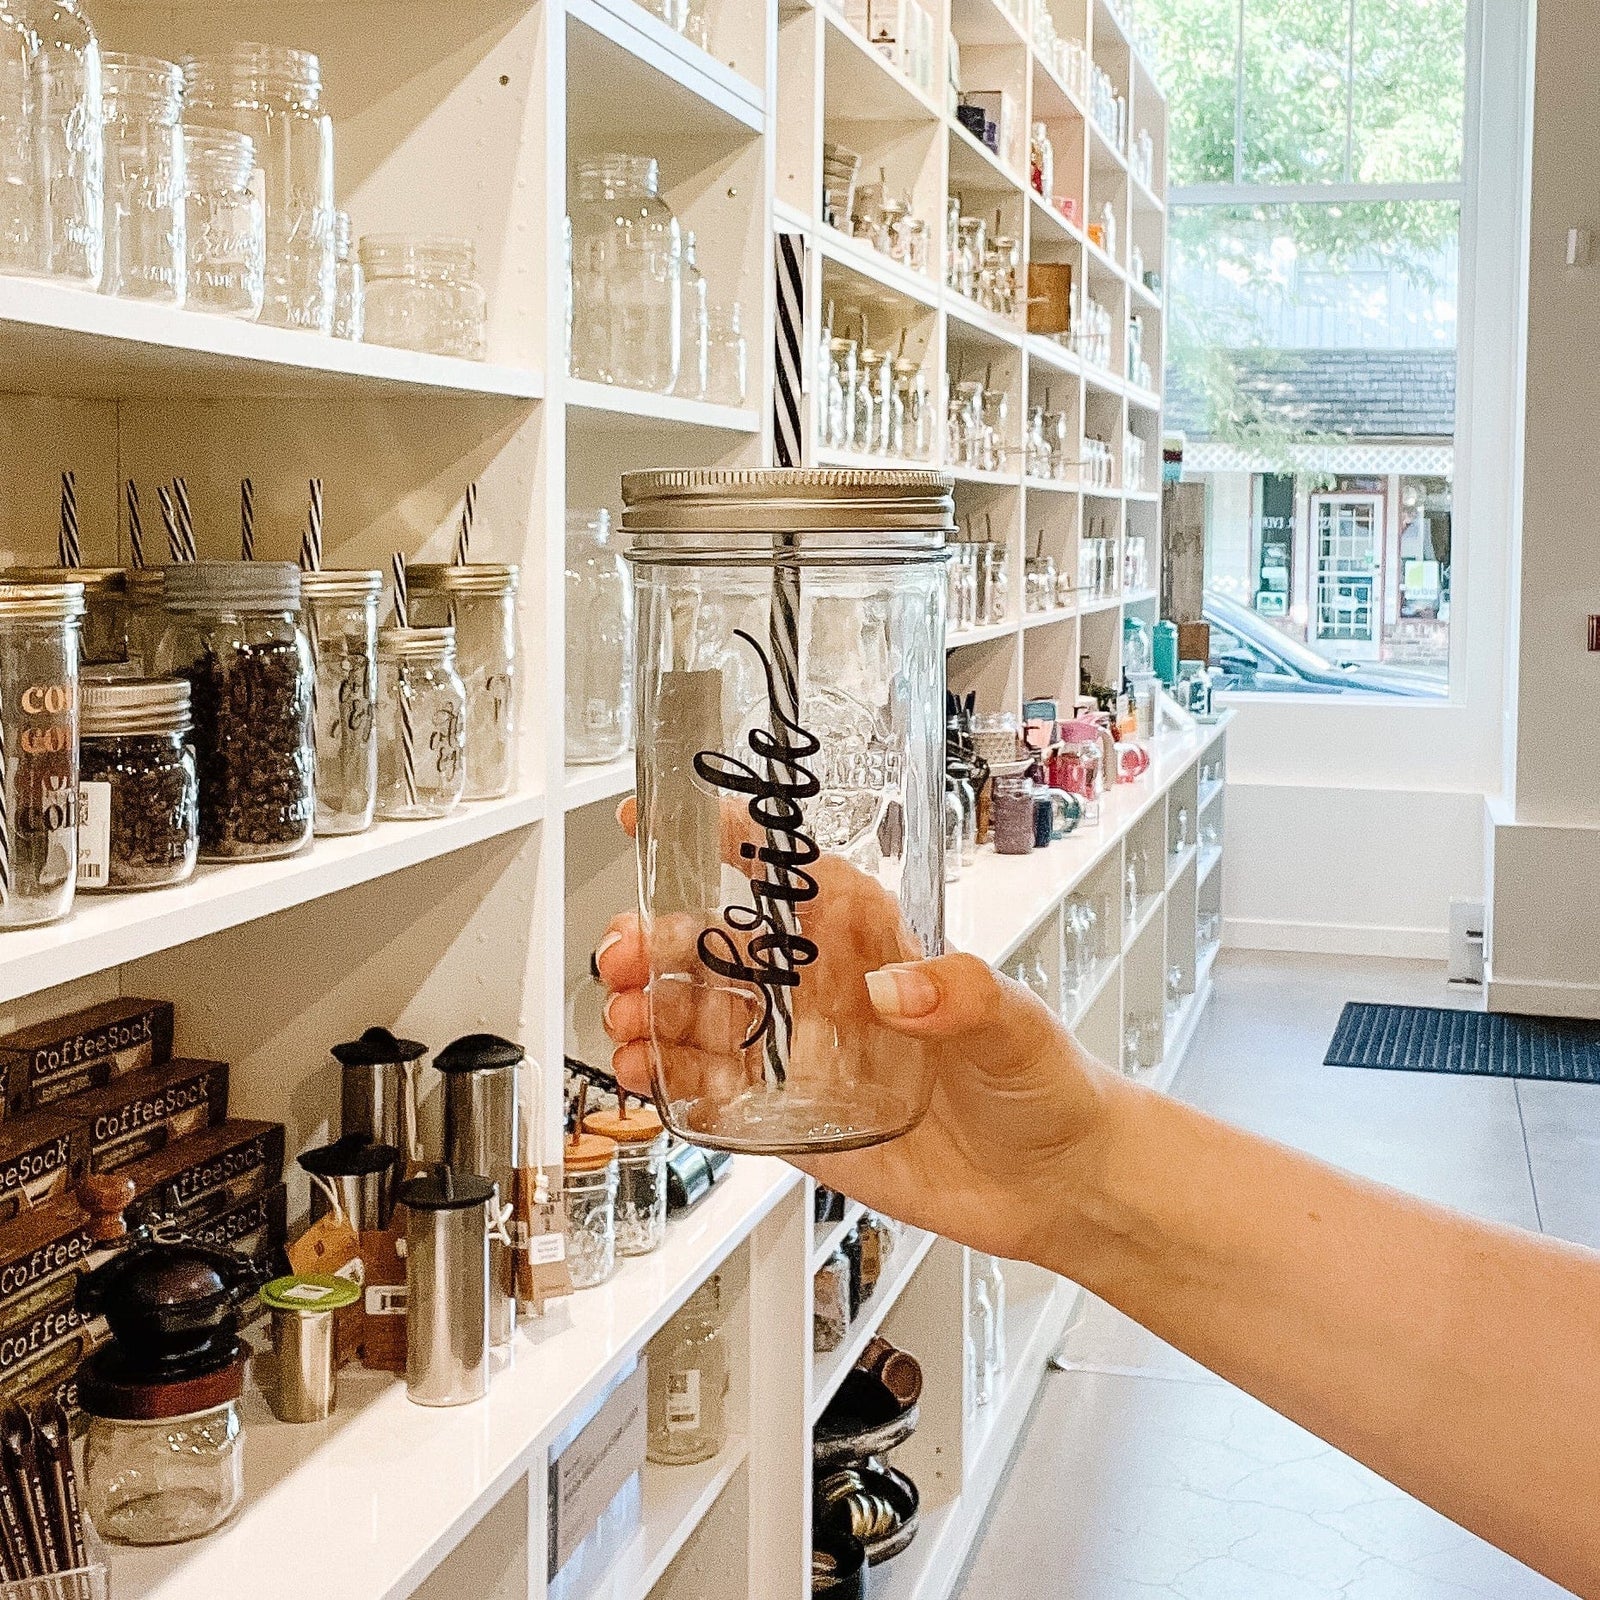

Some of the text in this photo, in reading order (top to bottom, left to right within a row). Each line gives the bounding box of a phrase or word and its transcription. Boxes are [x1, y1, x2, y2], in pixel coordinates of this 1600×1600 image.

[692, 628, 820, 1049] bride
[35, 1015, 152, 1074] CoffeeSock
[95, 1077, 208, 1140] CoffeeSock
[180, 1140, 266, 1197] ffeeSock
[1, 1231, 93, 1294] CoffeeS
